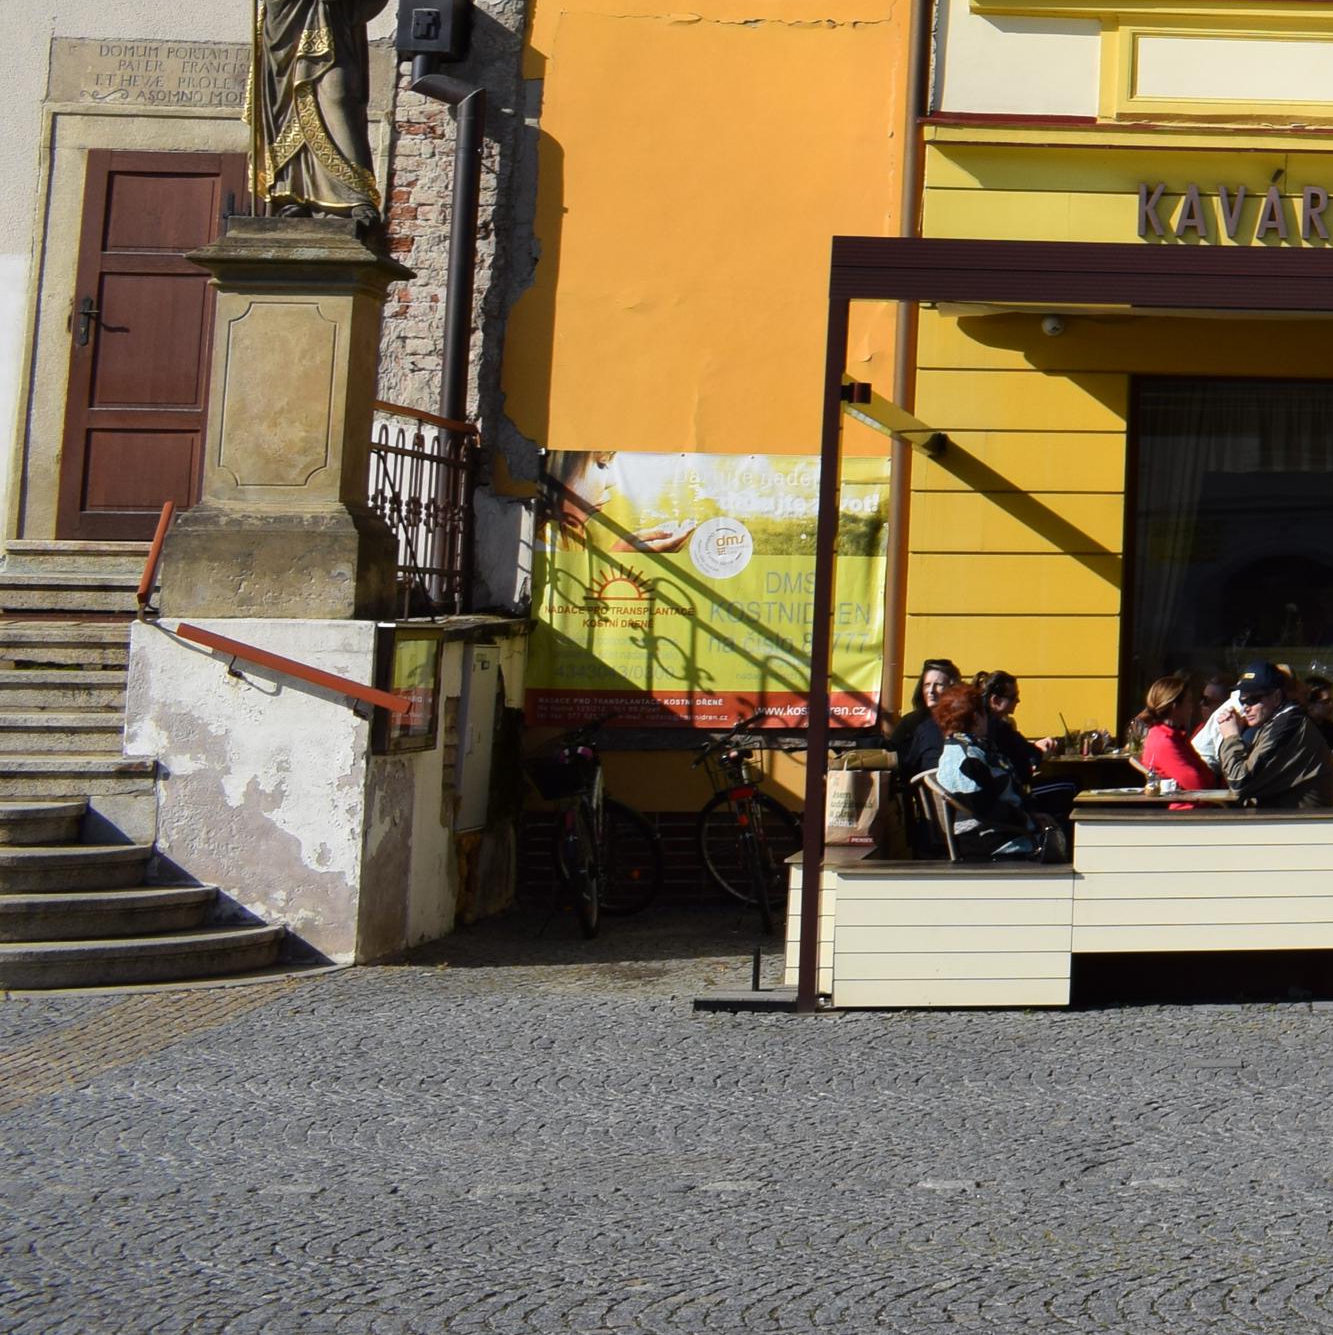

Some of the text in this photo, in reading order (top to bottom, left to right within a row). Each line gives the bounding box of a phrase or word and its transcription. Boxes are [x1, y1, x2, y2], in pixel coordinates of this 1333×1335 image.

[100, 45, 159, 58] DOMUM
[167, 46, 229, 60] PORTAM
[119, 60, 164, 72] PATER
[96, 74, 116, 86] ET
[716, 534, 745, 547] dms
[766, 571, 815, 594] DMS
[545, 606, 696, 616] NADACE PRO TRANSPLANTACE
[711, 601, 872, 625] KOSTNIDEN
[583, 618, 619, 628] KOSTNÍ
[708, 636, 736, 653] na
[744, 629, 794, 653] číslo
